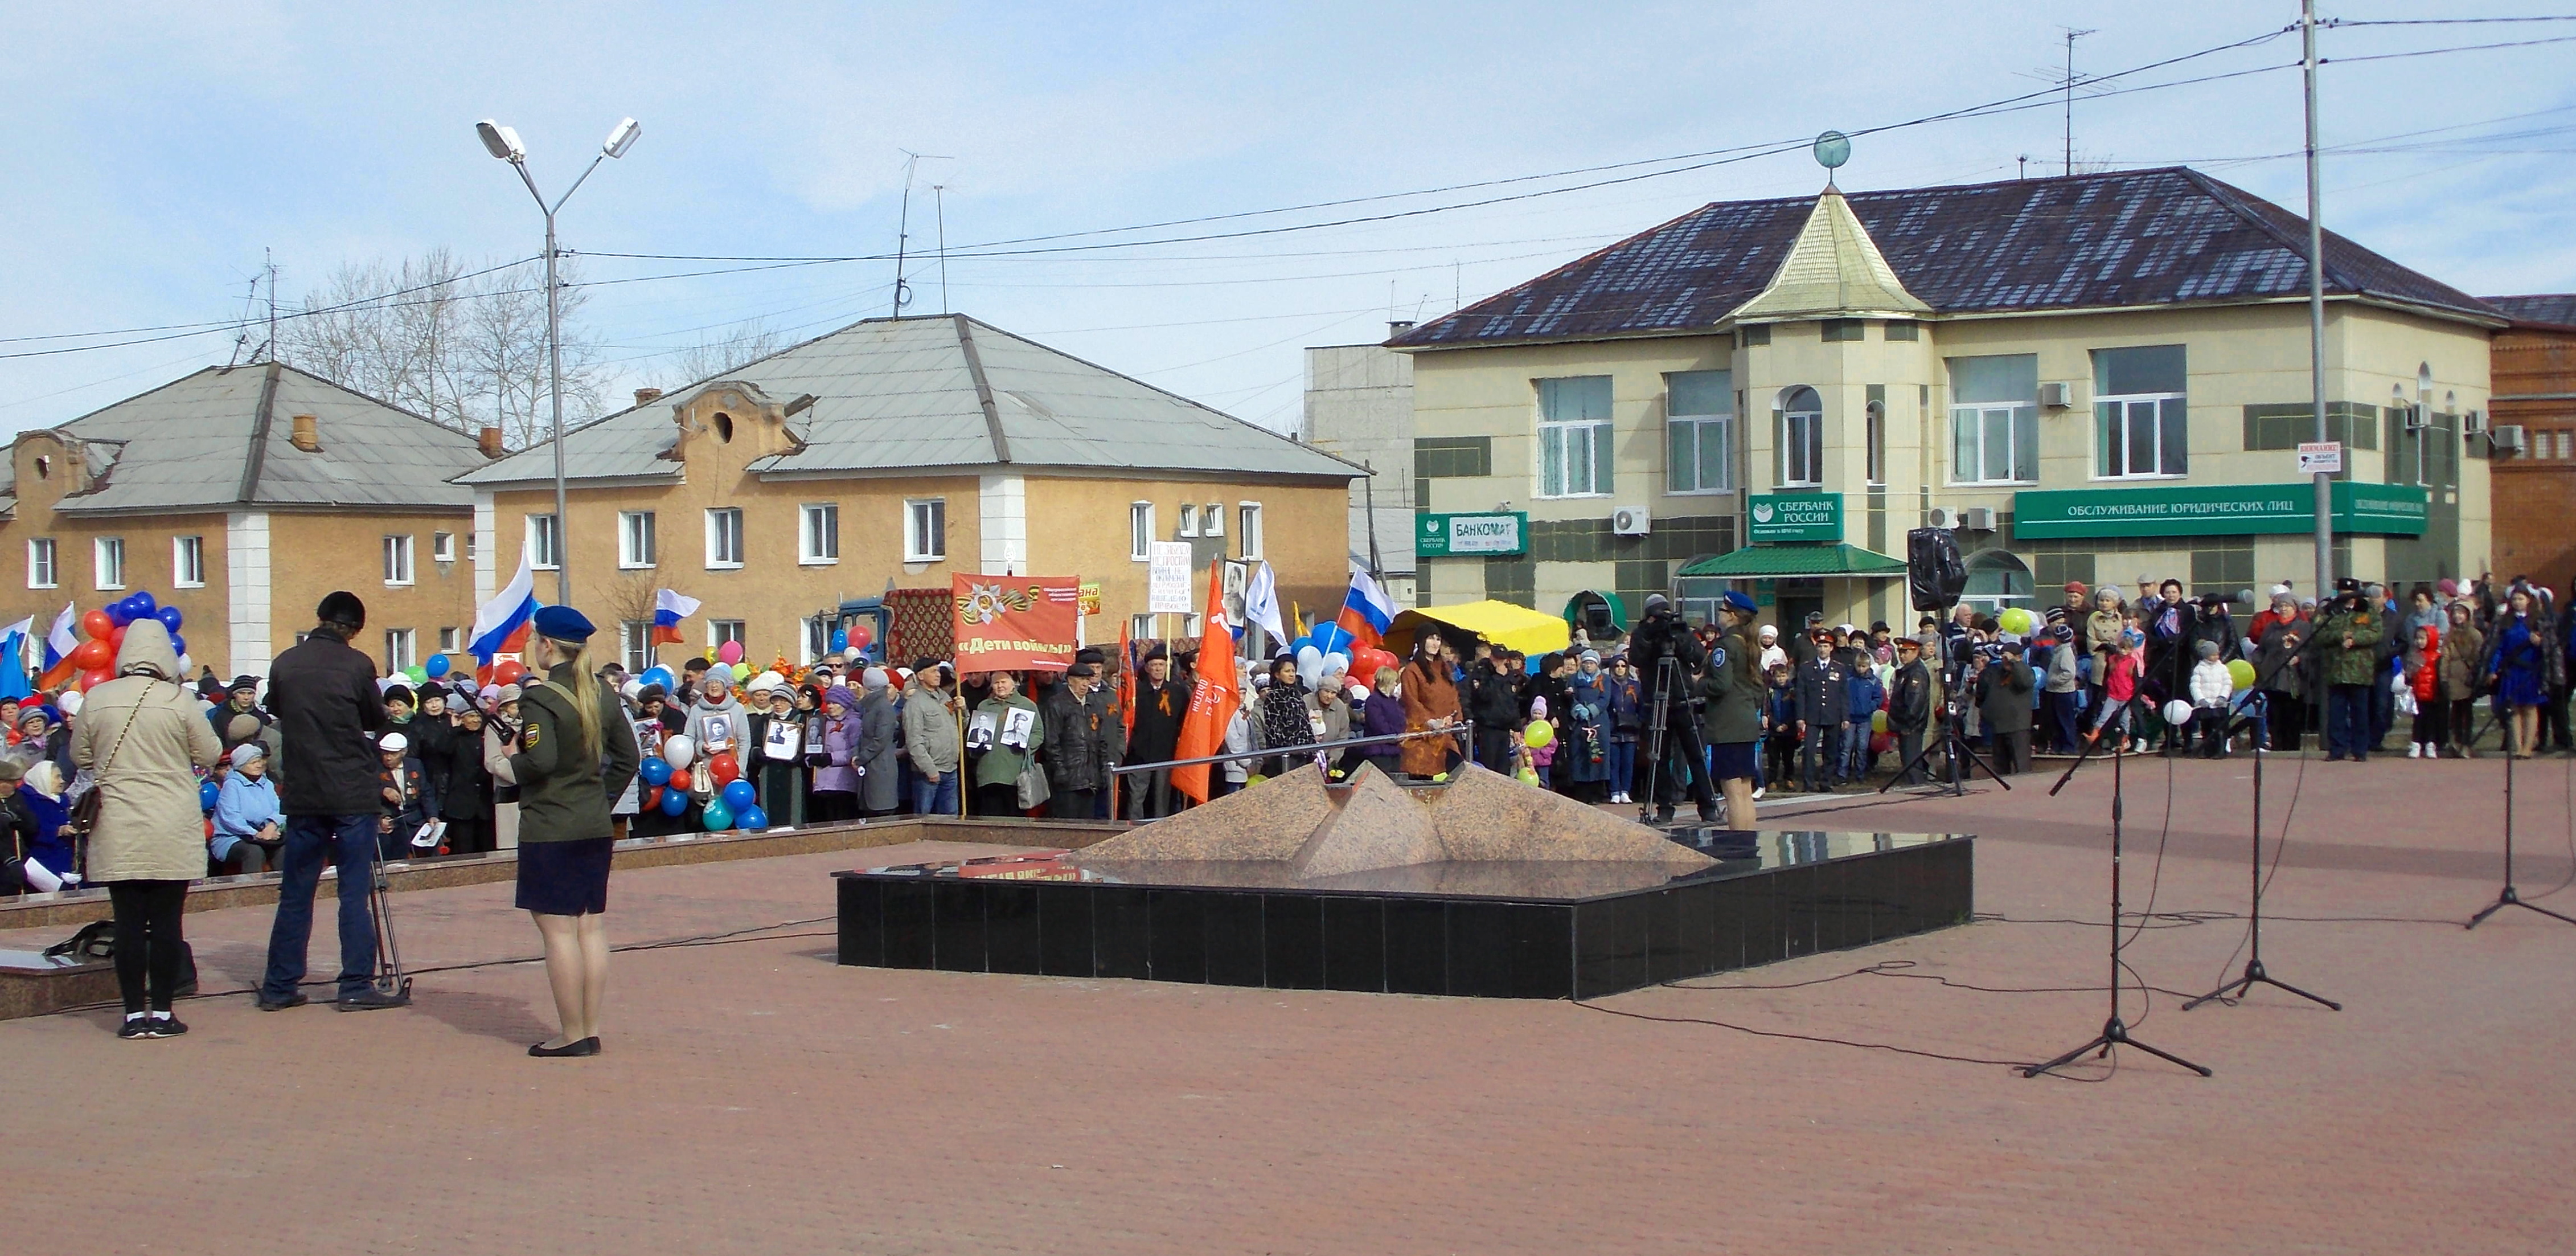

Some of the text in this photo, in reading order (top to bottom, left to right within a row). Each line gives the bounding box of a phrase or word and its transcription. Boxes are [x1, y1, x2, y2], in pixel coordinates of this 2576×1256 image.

[1778, 501, 1834, 512] СБЕРБАНК
[2068, 500, 2295, 516] ОБСЛУЖИВАНИЕ ЮРИДИЧЕСКИХ ЛИЦ
[1784, 513, 1829, 523] РОССИИ
[1152, 556, 1191, 566] НЕ ПРОСТИМ
[1079, 588, 1098, 597] ана
[958, 637, 1072, 654] «Дети войны»
